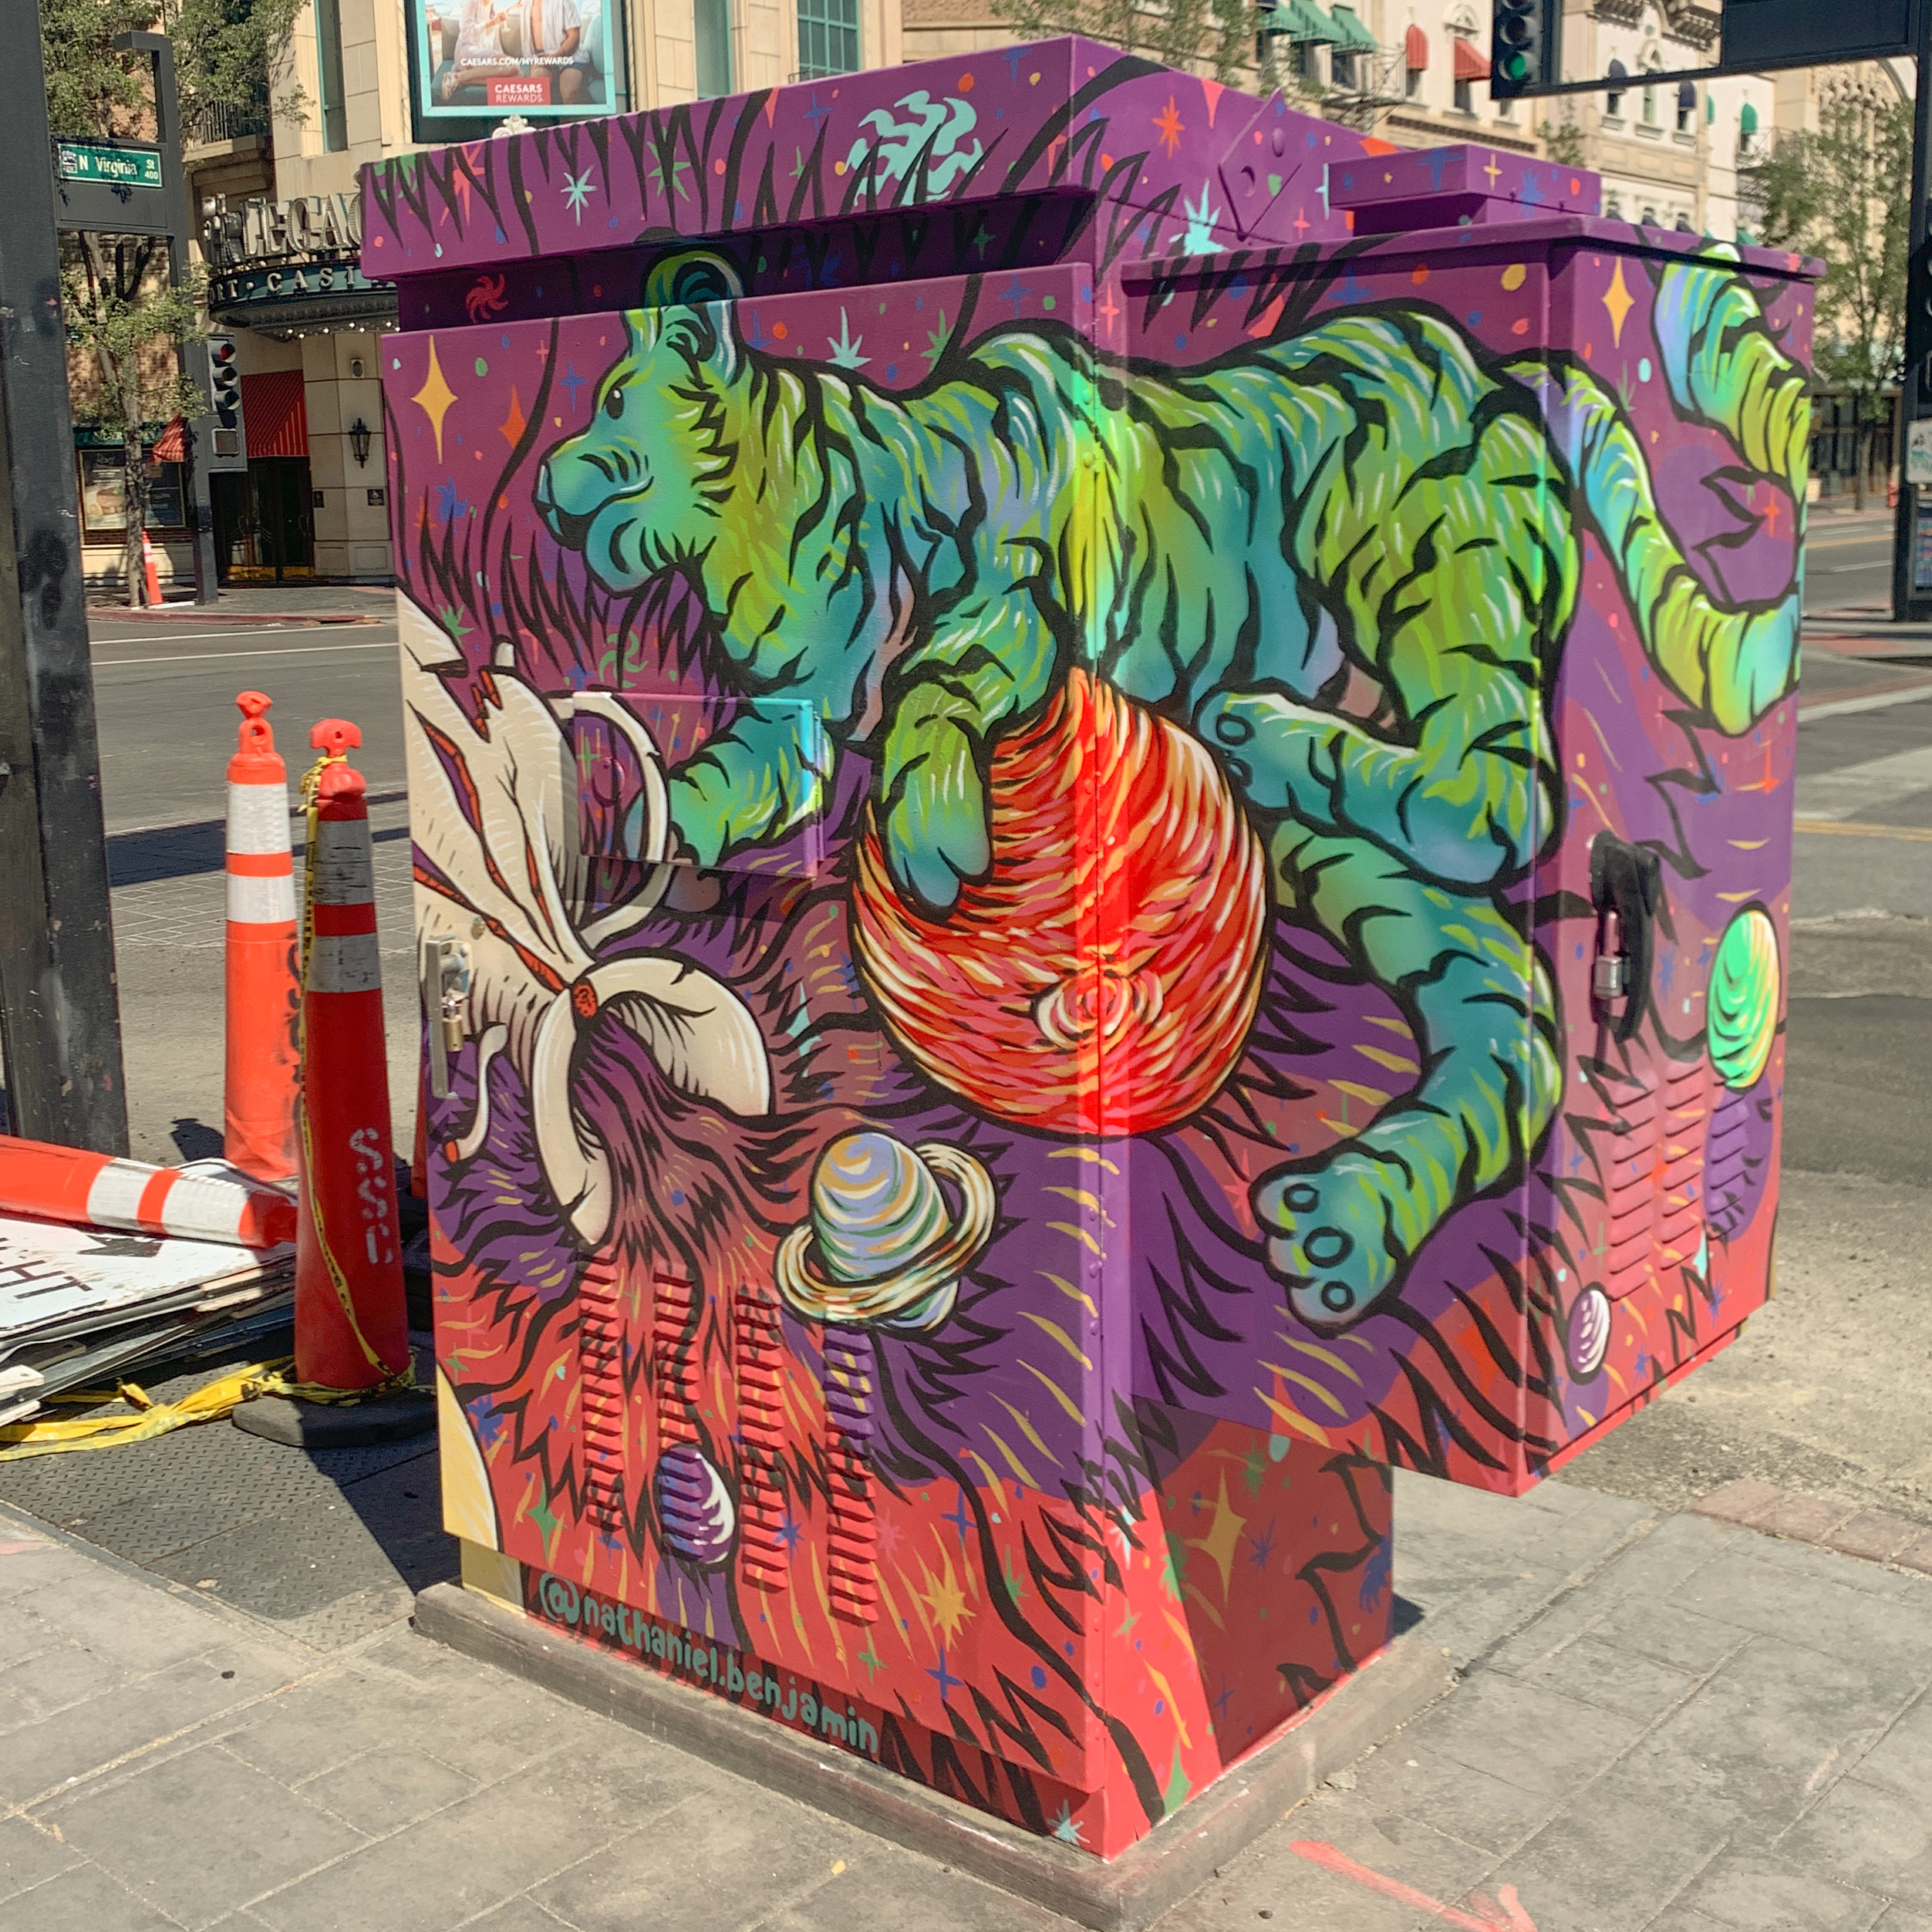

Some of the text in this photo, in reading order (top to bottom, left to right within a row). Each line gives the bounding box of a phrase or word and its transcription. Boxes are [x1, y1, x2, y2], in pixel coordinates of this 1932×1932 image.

[460, 56, 574, 66] CAESARS.COM/MYREWARDS
[495, 84, 543, 93] CAESARS
[79, 155, 89, 171] N
[95, 157, 137, 178] Virginia
[146, 159, 155, 170] St
[144, 170, 159, 180] 400
[267, 266, 362, 292] CASI
[539, 1572, 878, 1755] @nathaniel.benjamin
